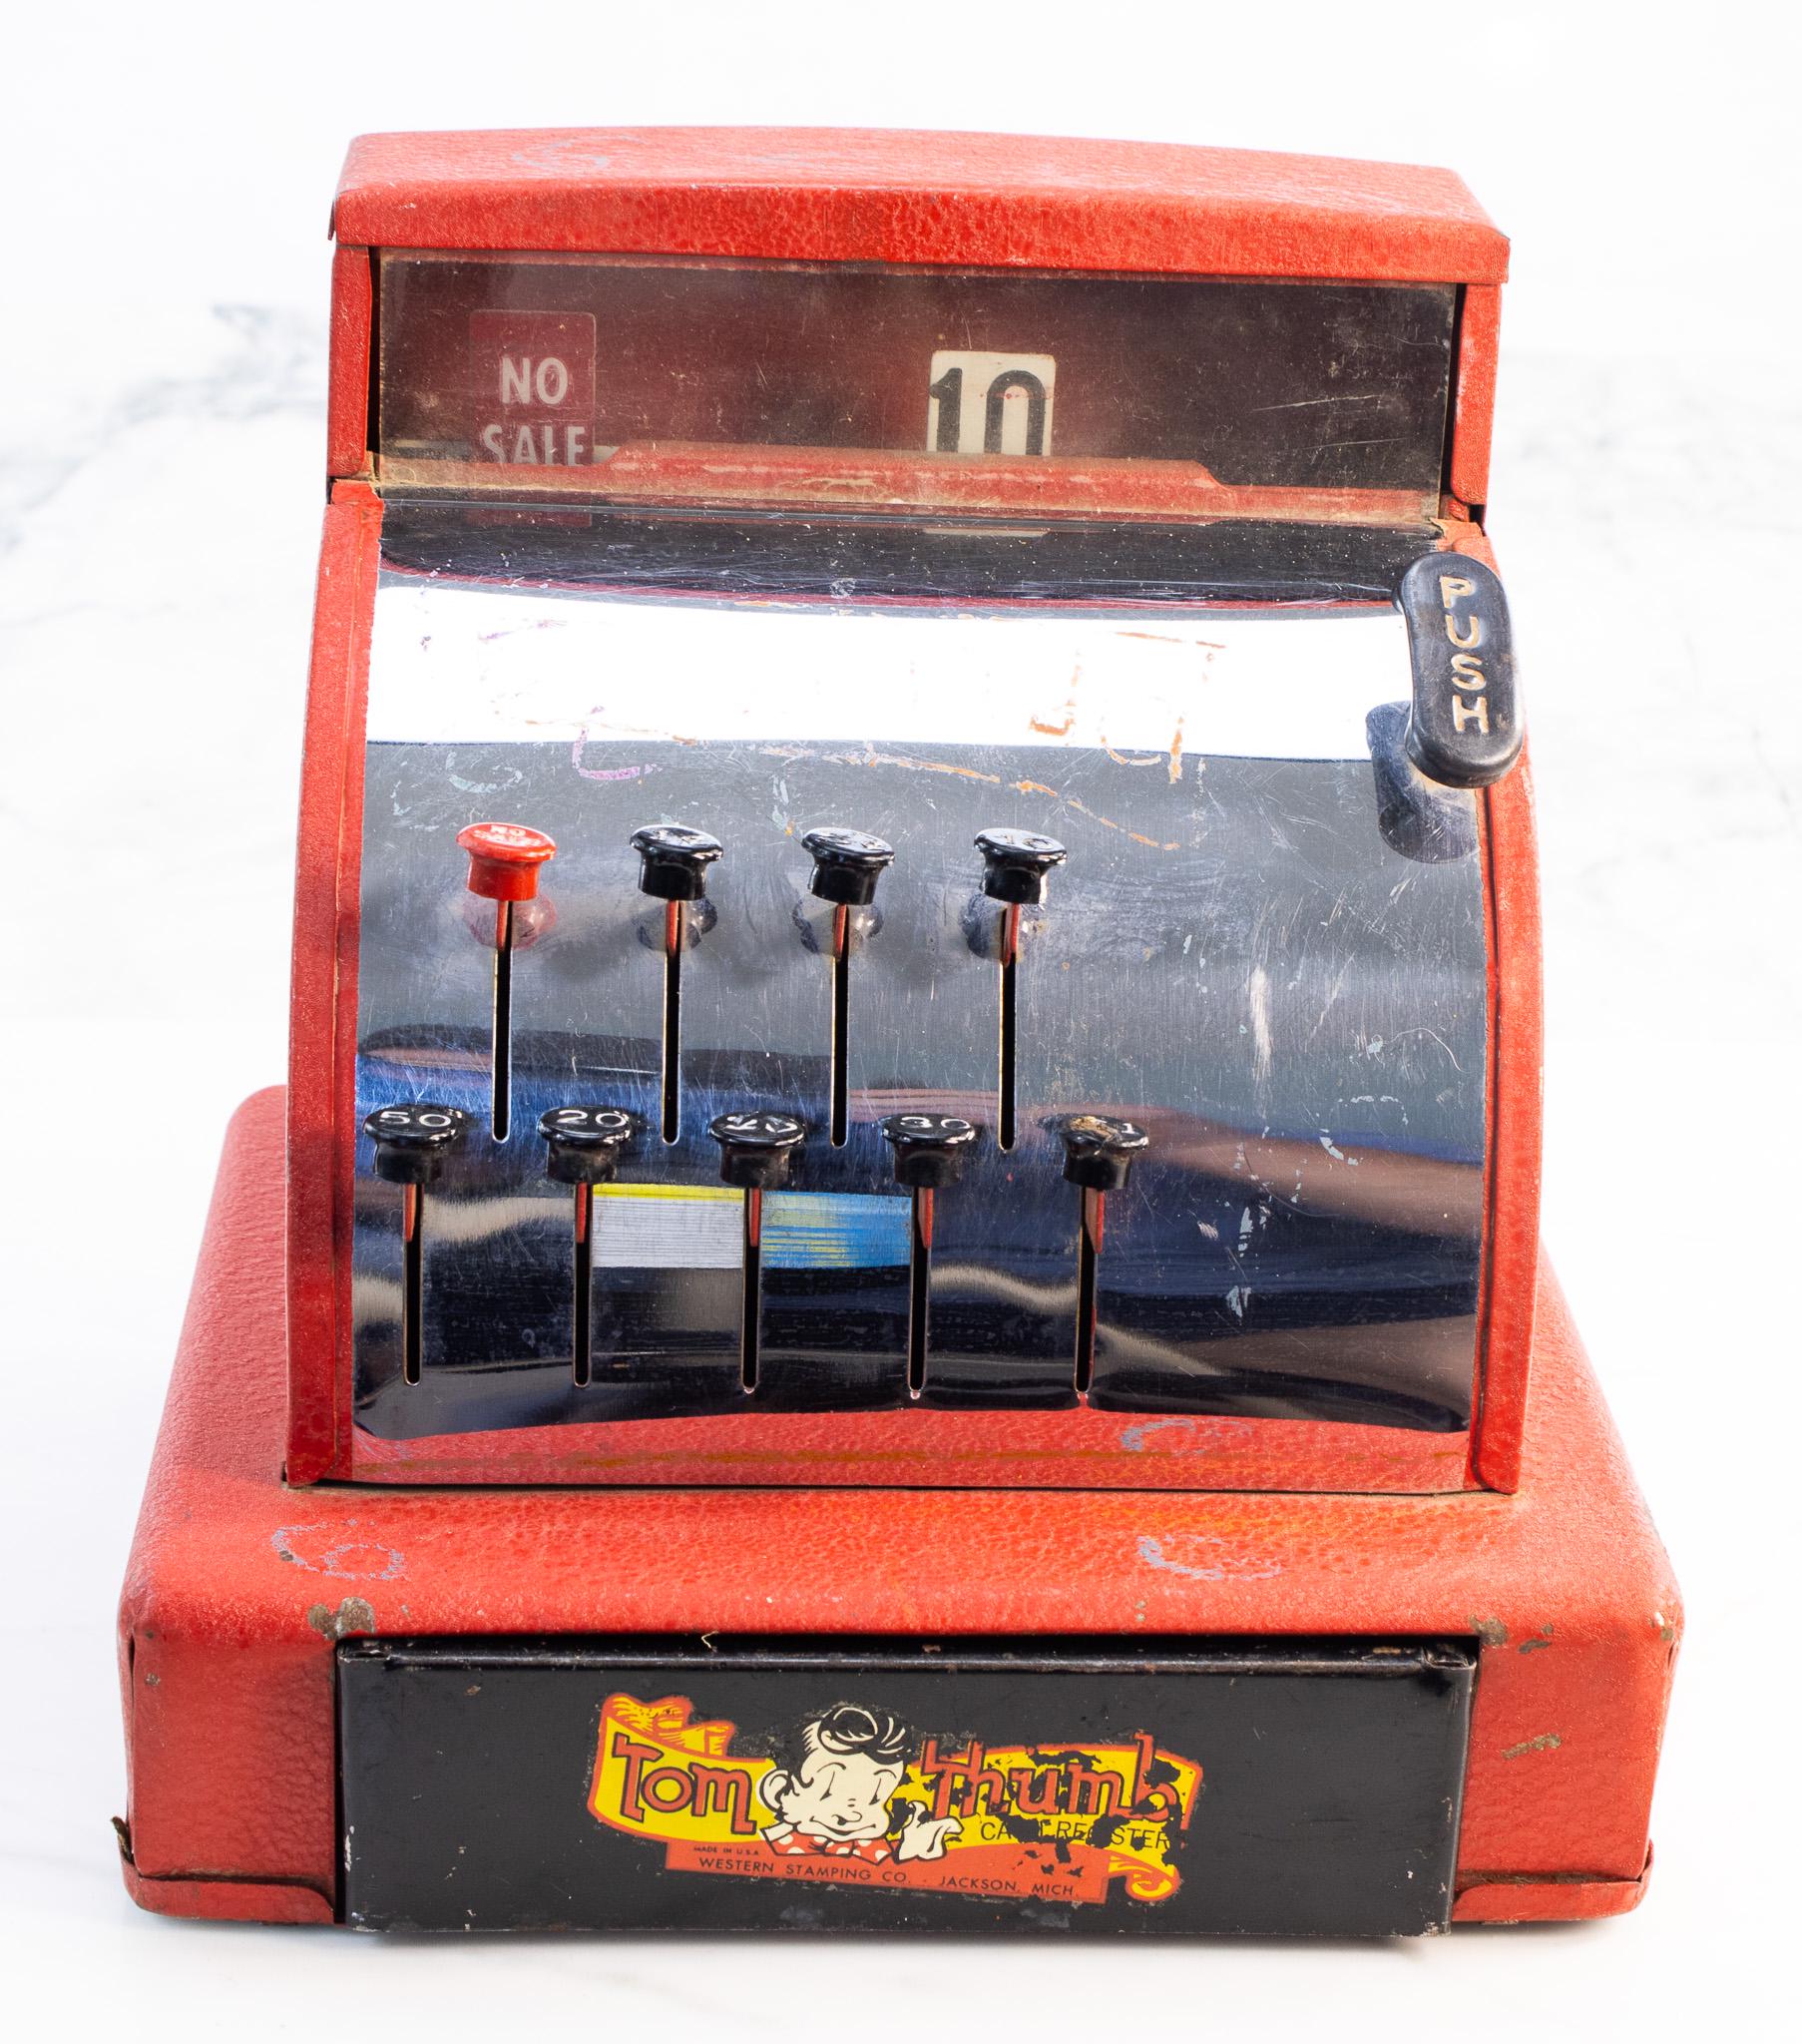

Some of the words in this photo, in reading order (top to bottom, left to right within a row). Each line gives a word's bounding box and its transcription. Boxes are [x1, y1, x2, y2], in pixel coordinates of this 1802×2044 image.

[502, 356, 569, 405] NO
[930, 367, 1046, 455] 10
[1440, 576, 1489, 734] PUSH
[379, 1111, 451, 1128] 50
[558, 1109, 629, 1128] 20
[900, 1116, 972, 1129] 30
[612, 1732, 757, 1835] Tom
[920, 1730, 1181, 1823] Thumb
[1056, 1820, 1170, 1850] RESTER
[698, 1856, 774, 1873] WESTERN
[785, 1862, 871, 1880] STAMPING
